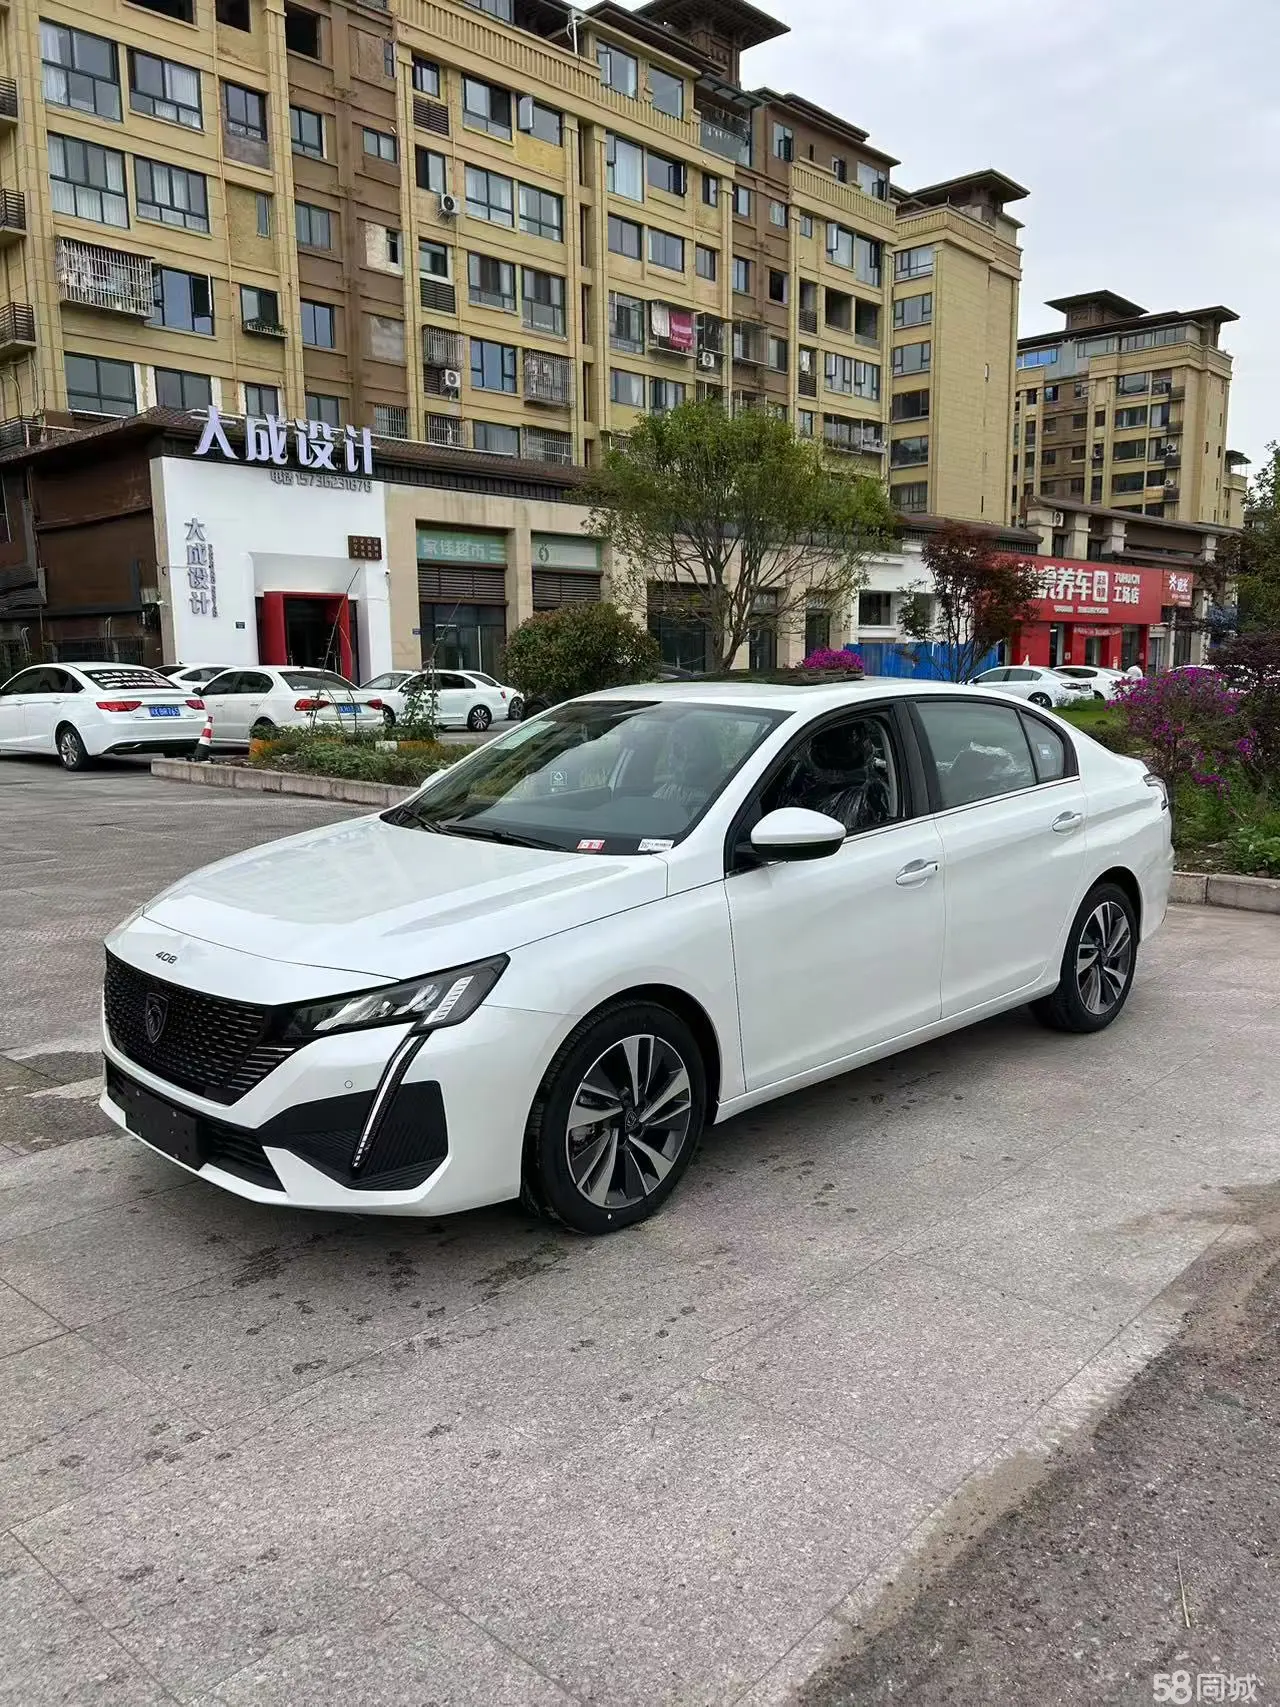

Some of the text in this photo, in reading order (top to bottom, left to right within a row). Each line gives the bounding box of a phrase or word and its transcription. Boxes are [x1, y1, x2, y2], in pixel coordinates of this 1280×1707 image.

[190, 405, 377, 475] 大成设计
[184, 517, 210, 614] 大成设计
[155, 951, 178, 964] 408
